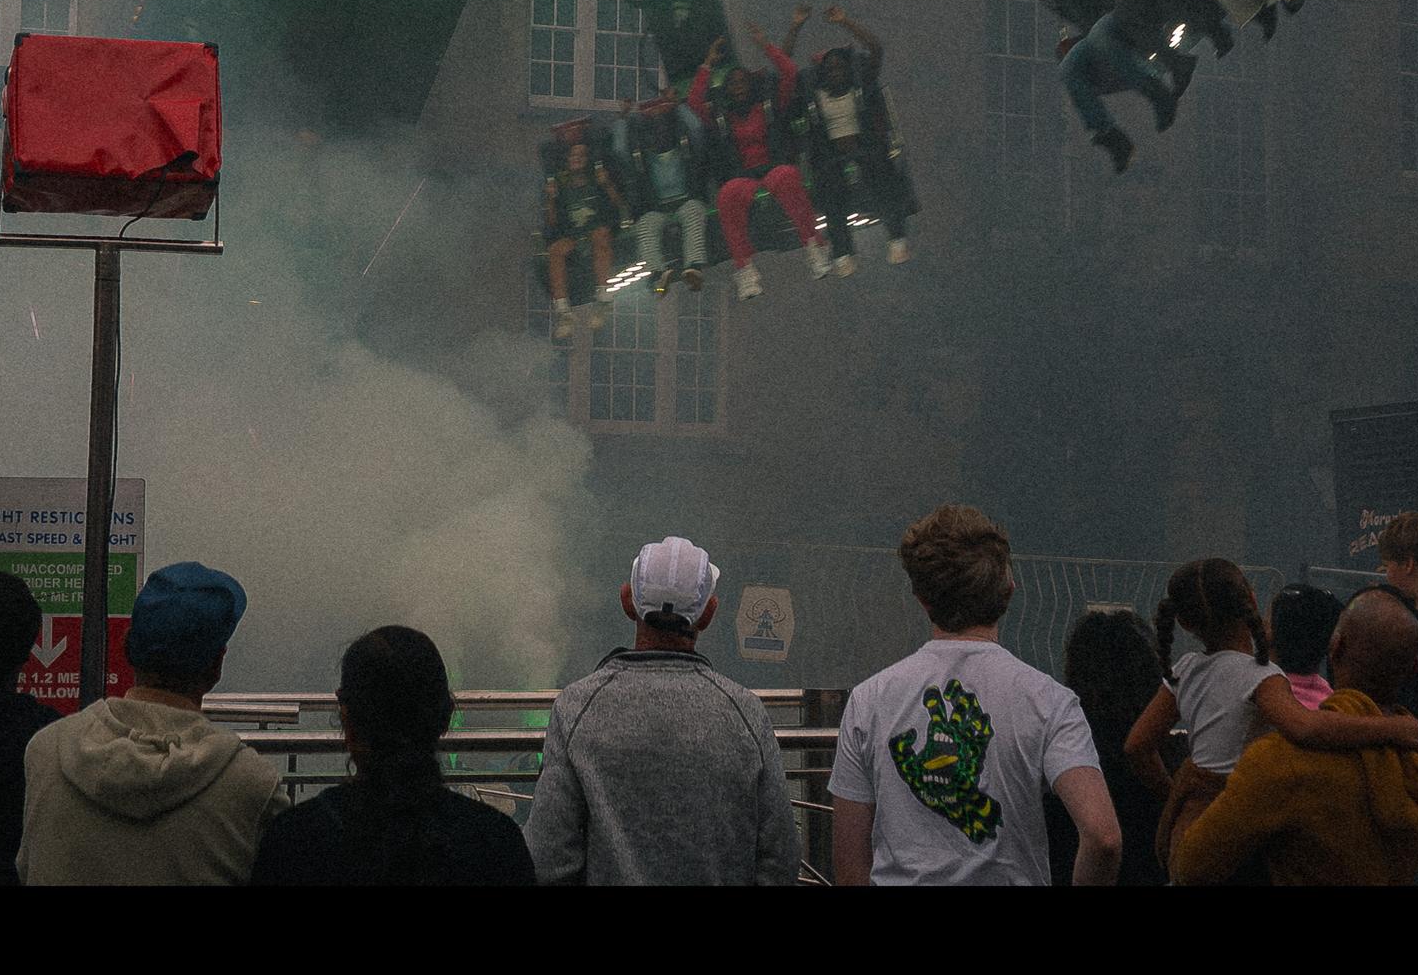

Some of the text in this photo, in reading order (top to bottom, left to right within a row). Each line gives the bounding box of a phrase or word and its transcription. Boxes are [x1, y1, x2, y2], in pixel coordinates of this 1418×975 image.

[31, 511, 135, 525] RESTICNS
[27, 533, 68, 544] SPEED
[72, 534, 83, 544] &
[12, 563, 123, 575] UNACCOMPED
[23, 577, 61, 589] RIDER
[50, 592, 85, 603] METR
[31, 673, 53, 684] 1.2
[57, 673, 119, 685] MES
[29, 687, 81, 699] ALLOW
